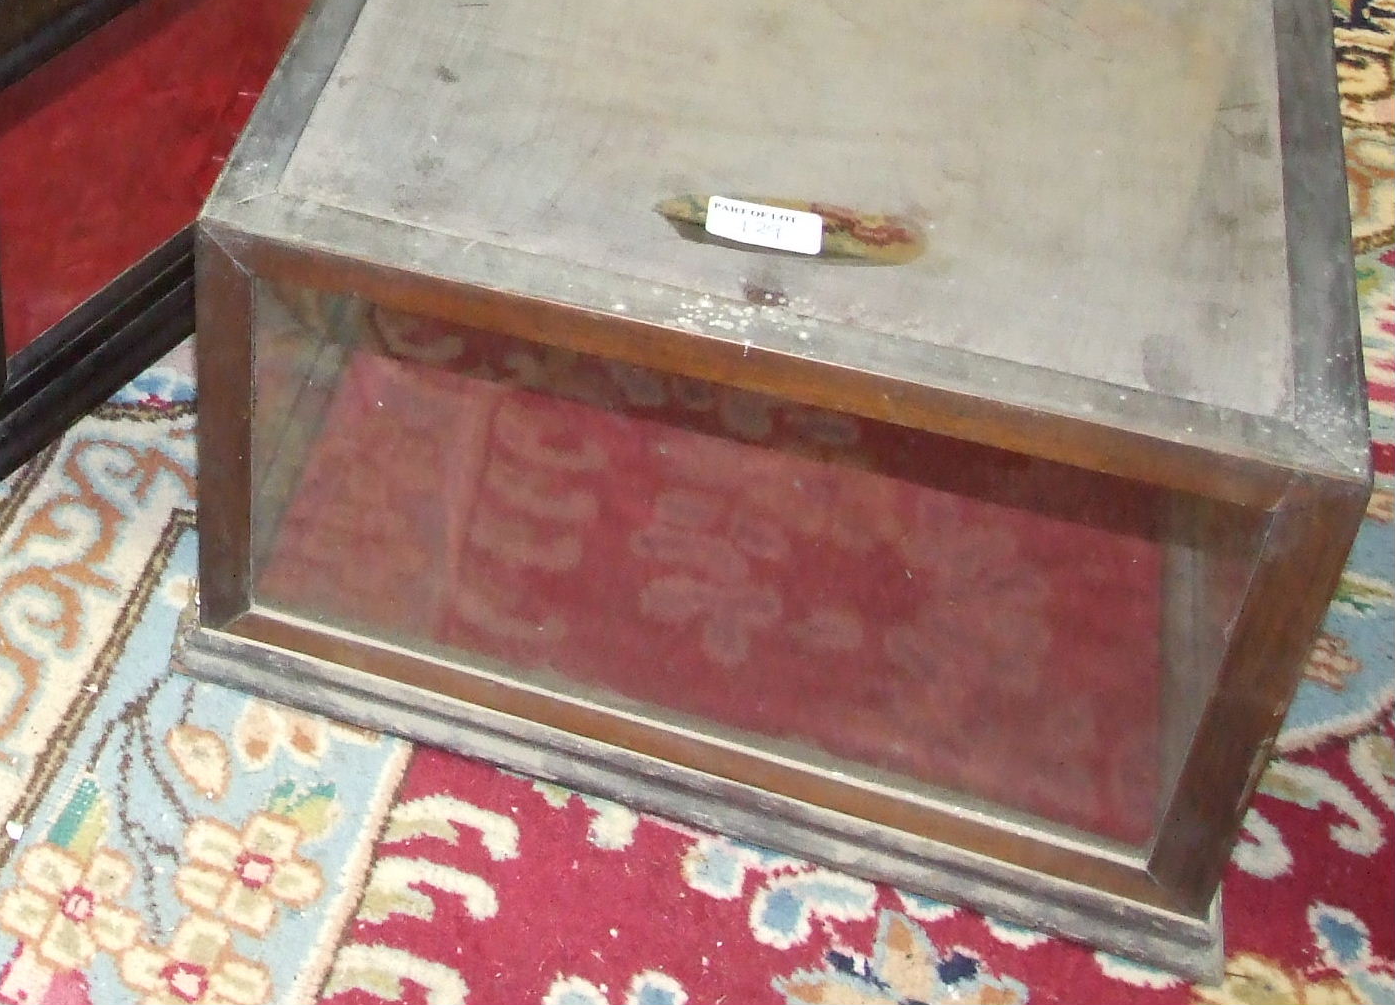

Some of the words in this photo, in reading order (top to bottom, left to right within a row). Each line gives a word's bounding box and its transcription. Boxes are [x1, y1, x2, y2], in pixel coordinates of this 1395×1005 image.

[714, 202, 747, 214] PART
[750, 210, 766, 218] OF
[771, 213, 796, 223] LOT
